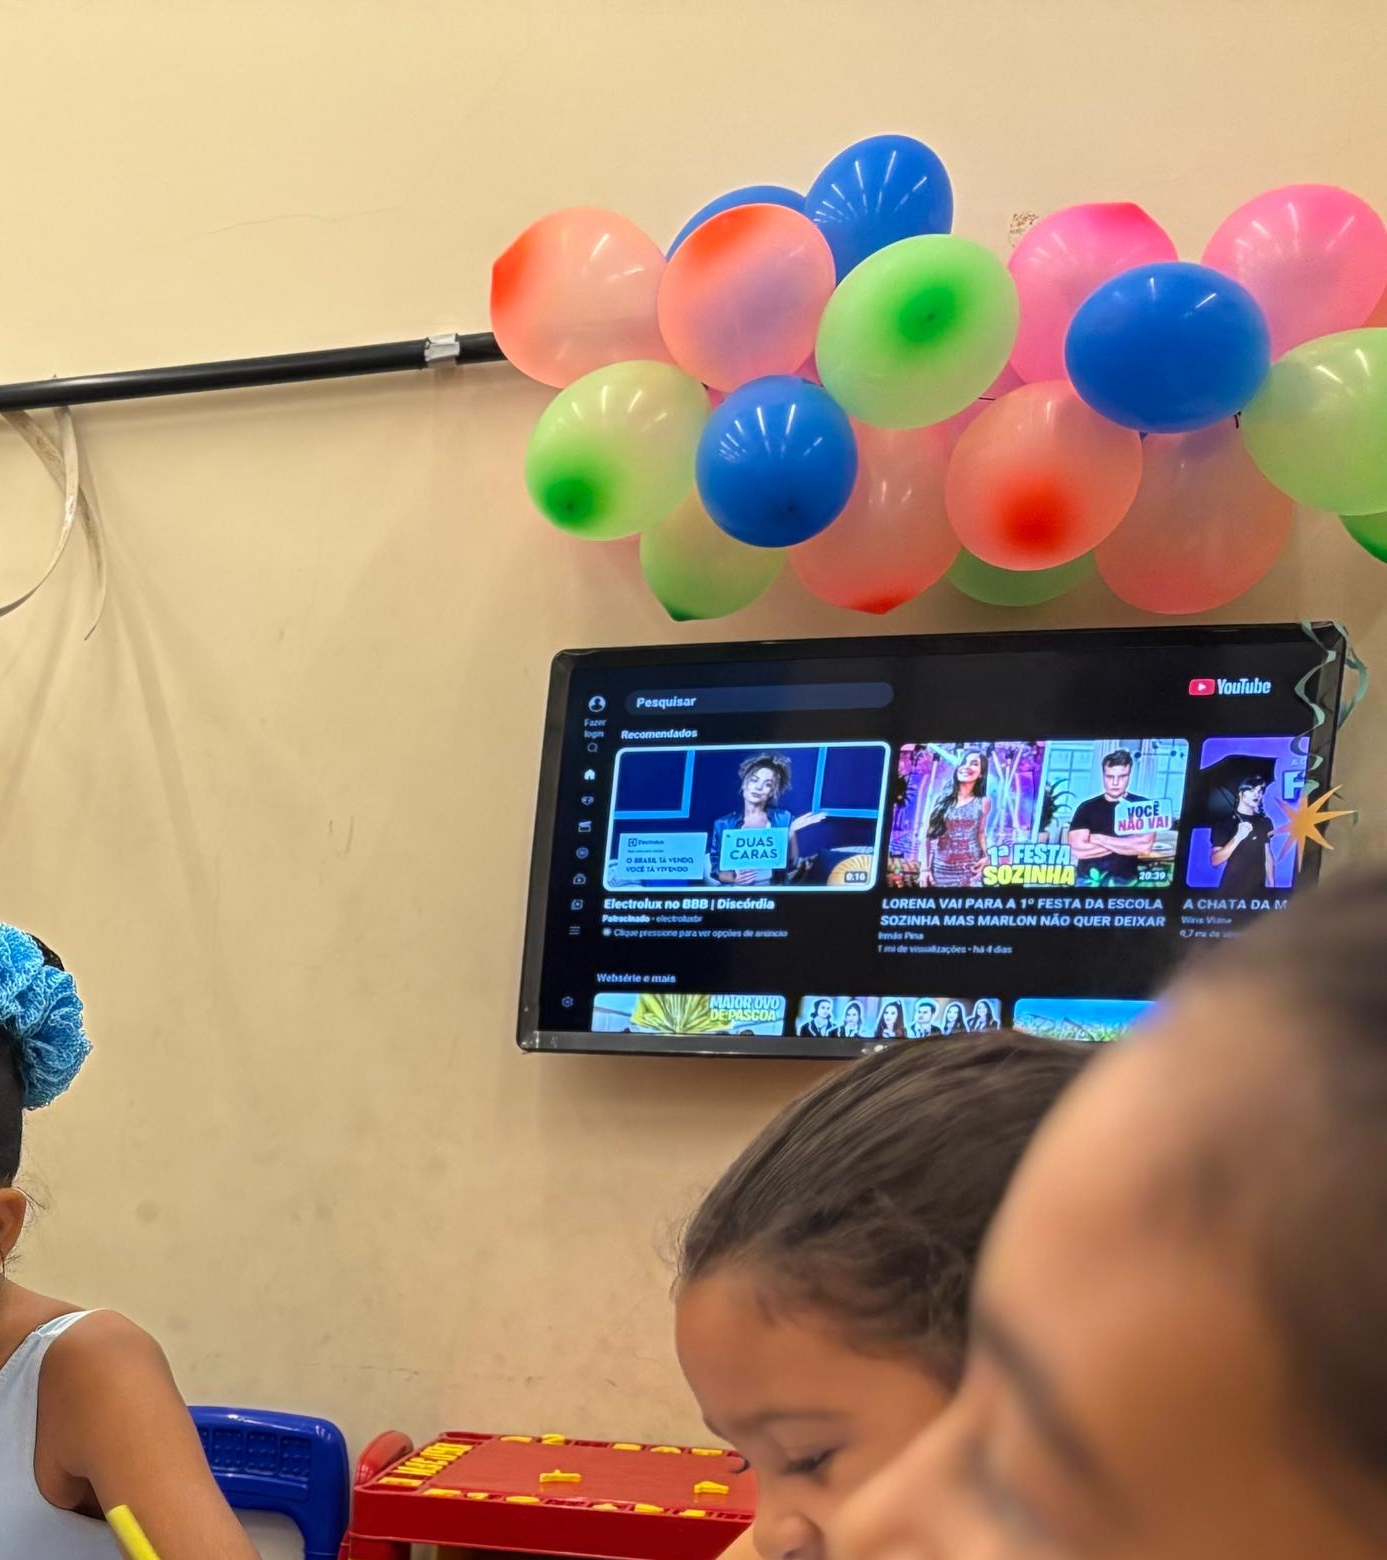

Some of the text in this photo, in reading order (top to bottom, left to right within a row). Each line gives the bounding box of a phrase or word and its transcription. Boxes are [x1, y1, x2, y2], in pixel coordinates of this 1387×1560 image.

[1217, 677, 1272, 695] YouTube
[636, 696, 697, 710] Pesquisar
[584, 718, 607, 728] Fazer
[584, 729, 605, 740] login
[621, 729, 698, 740] Recomendados
[1127, 801, 1160, 818] VOCÊ
[1118, 816, 1169, 832] NÃO VAI
[736, 837, 774, 848] DUAS
[730, 849, 778, 860] CARAS
[1012, 844, 1071, 866] FESTA
[983, 864, 1076, 886] SOZINHA
[604, 898, 663, 910] Electrolux
[665, 901, 680, 910] no
[682, 899, 708, 910] BBB
[717, 898, 775, 910] Discórdia
[882, 898, 935, 910] LORENA
[939, 898, 962, 910] VAI
[965, 898, 1003, 910] PARA
[1005, 898, 1016, 910] A
[1038, 898, 1081, 910] FESTA
[1085, 898, 1104, 910] DA
[1107, 898, 1163, 910] ESCOLA
[1183, 899, 1194, 910] A
[1197, 899, 1247, 910] CHATA
[1250, 899, 1270, 910] DA
[880, 913, 1166, 929] SOZINHA MAS MARLON NÃO QUER DEIXAR
